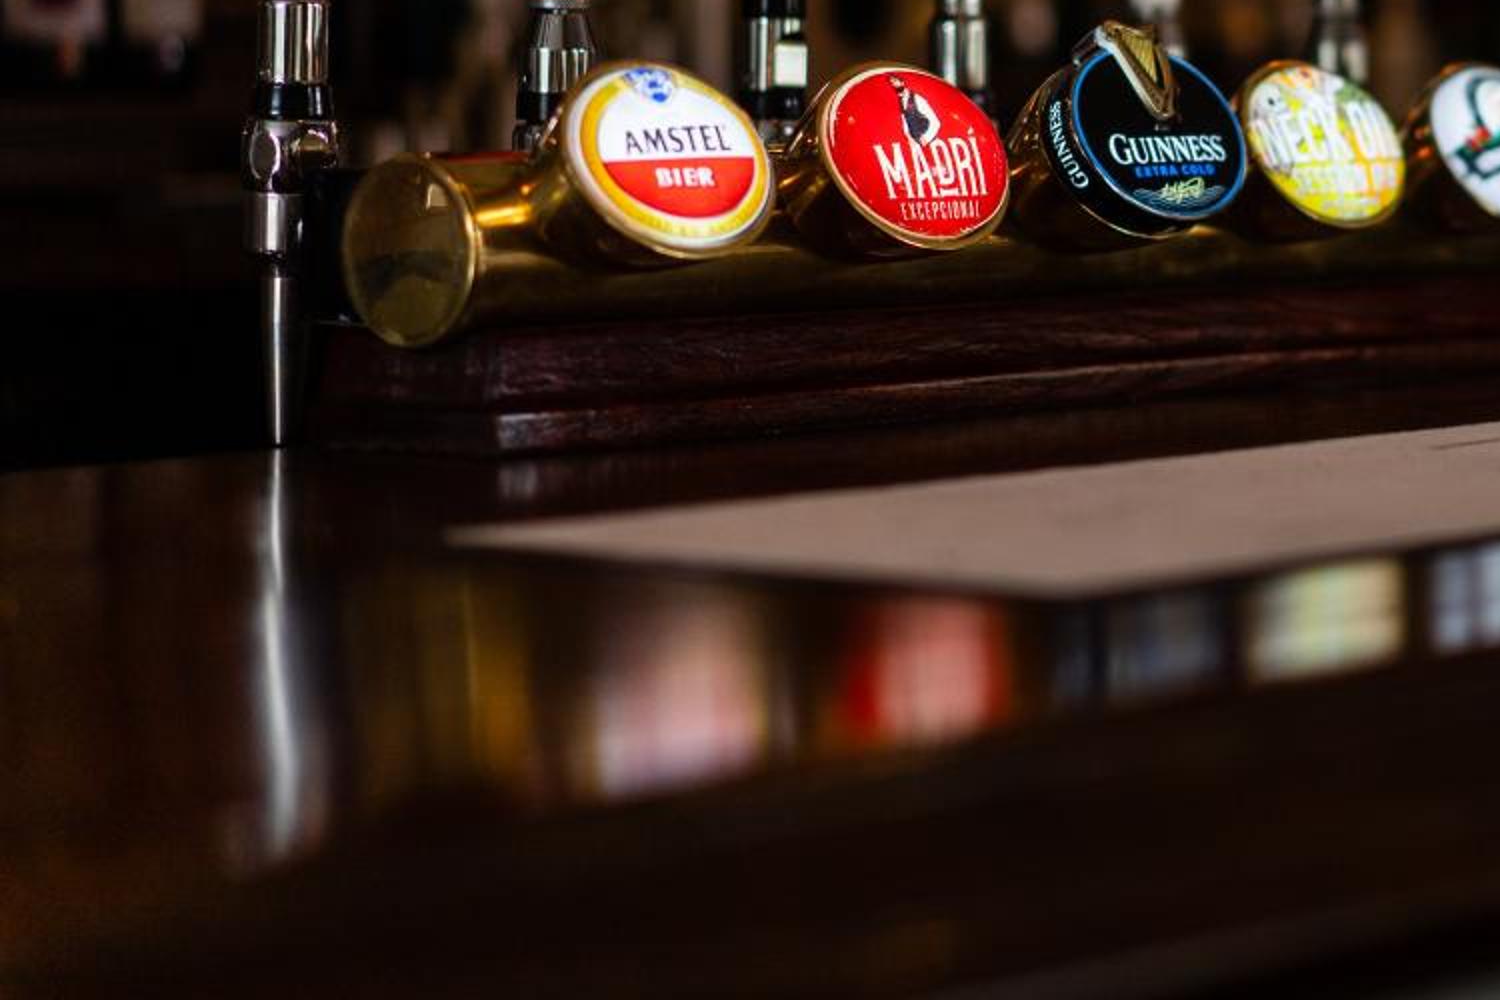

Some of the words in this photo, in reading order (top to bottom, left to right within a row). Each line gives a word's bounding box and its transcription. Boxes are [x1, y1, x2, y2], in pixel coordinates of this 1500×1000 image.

[625, 125, 732, 154] AMSTEL
[1049, 101, 1089, 188] GUINNESS
[1109, 133, 1227, 165] GUINNESS
[654, 167, 716, 188] BIER
[873, 126, 988, 200] MADRÍ
[1135, 165, 1178, 178] EXTRA
[1181, 164, 1216, 175] COLD
